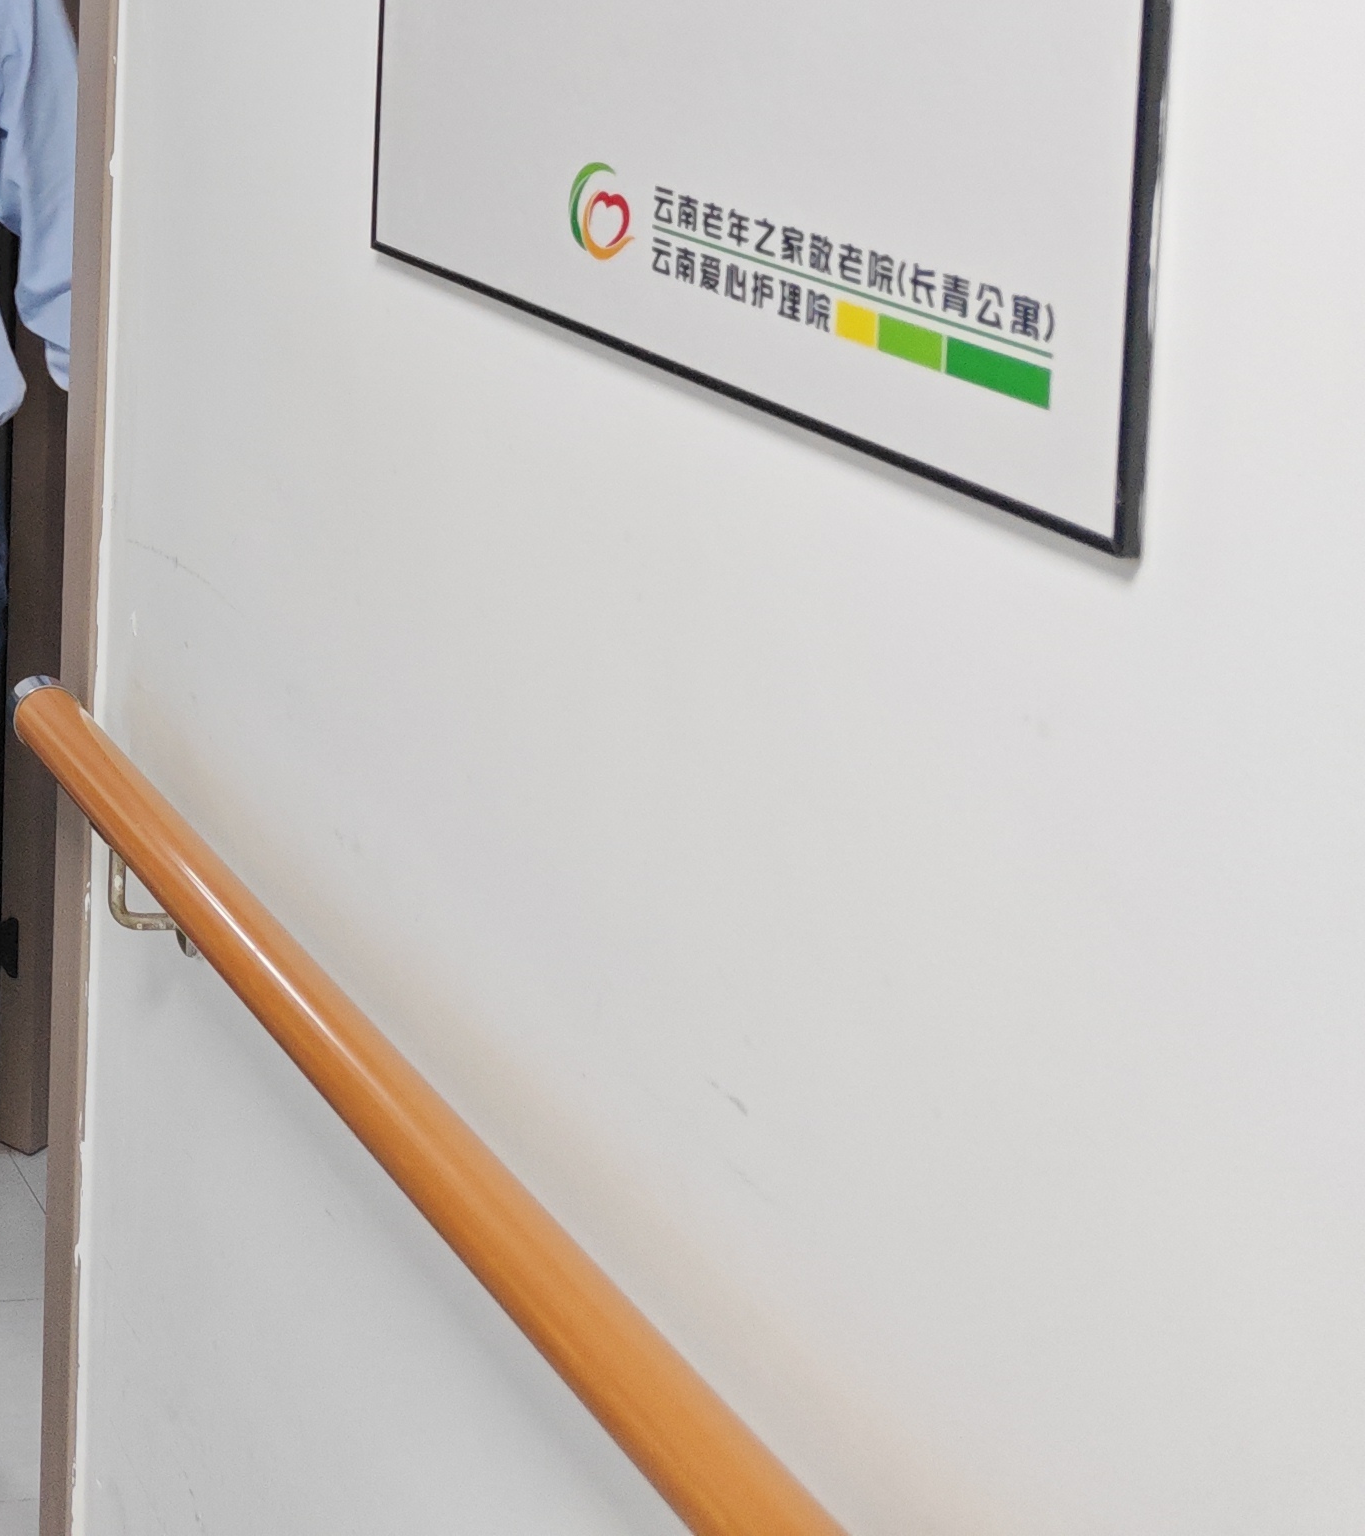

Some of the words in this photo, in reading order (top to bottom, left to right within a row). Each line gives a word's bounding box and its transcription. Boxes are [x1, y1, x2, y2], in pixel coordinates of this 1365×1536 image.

[650, 236, 832, 334] 云南爱心护理院
[652, 184, 1057, 344] 云南老年之家敬老院(长青公寓)
